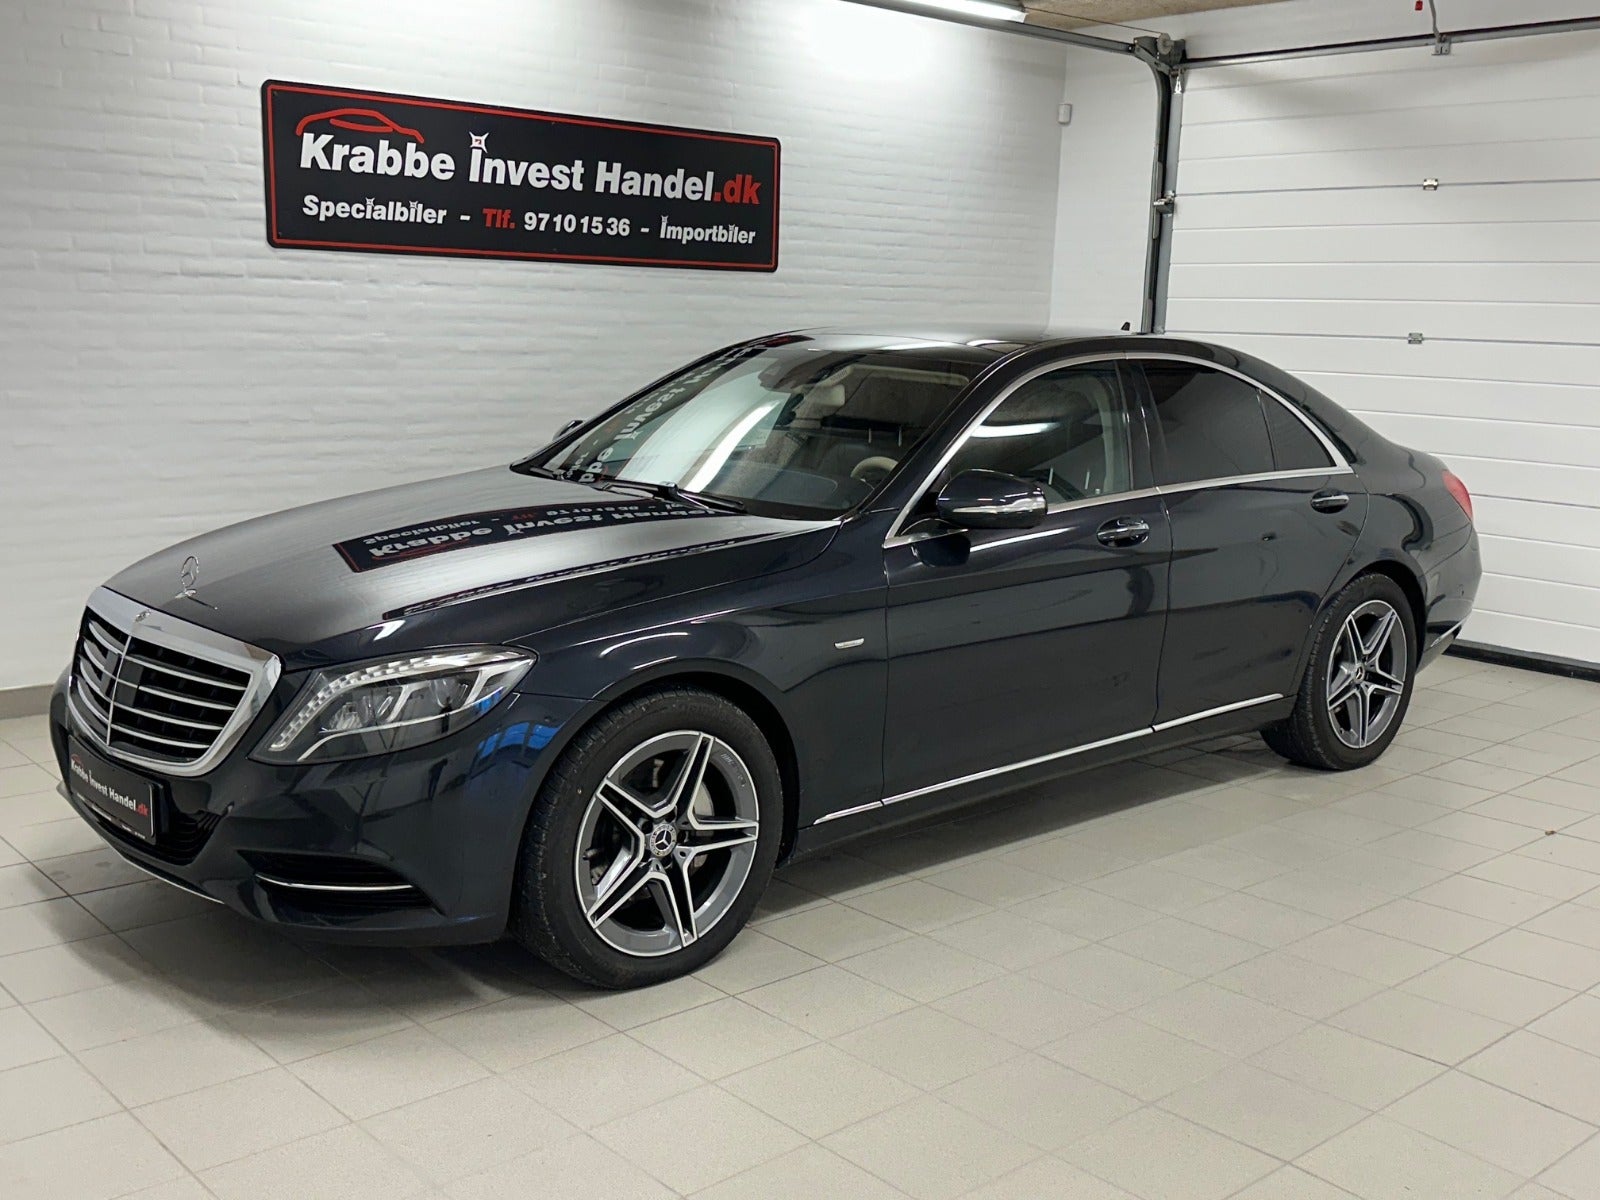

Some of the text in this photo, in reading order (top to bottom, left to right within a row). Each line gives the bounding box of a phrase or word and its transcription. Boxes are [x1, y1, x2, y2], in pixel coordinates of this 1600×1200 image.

[300, 131, 761, 205] Krabbe Invest Handel.dk
[302, 194, 447, 225] Specialbiler
[482, 207, 516, 230] Tlf.
[659, 214, 756, 245] Importbiler
